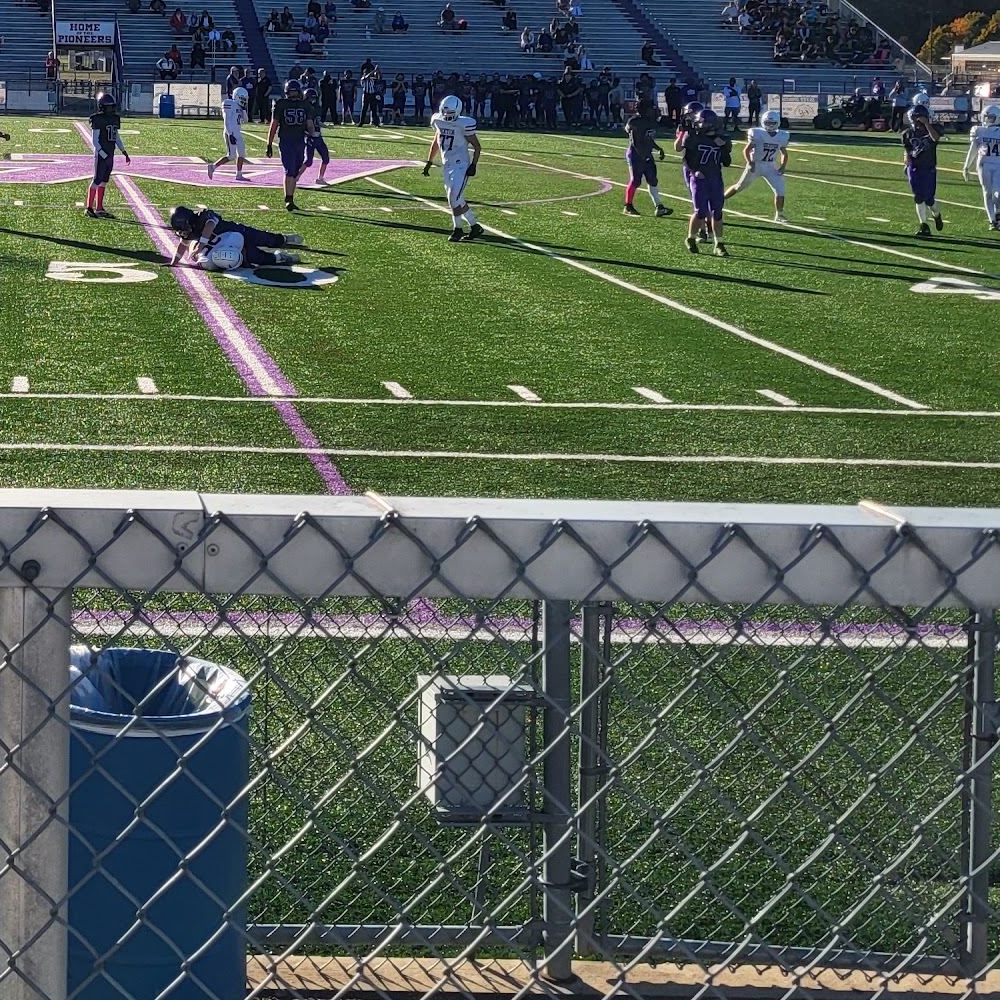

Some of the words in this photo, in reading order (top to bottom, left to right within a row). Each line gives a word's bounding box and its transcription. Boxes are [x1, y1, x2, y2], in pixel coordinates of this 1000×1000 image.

[69, 23, 101, 32] HOME
[57, 35, 112, 44] PIONEERS
[761, 148, 777, 162] 72
